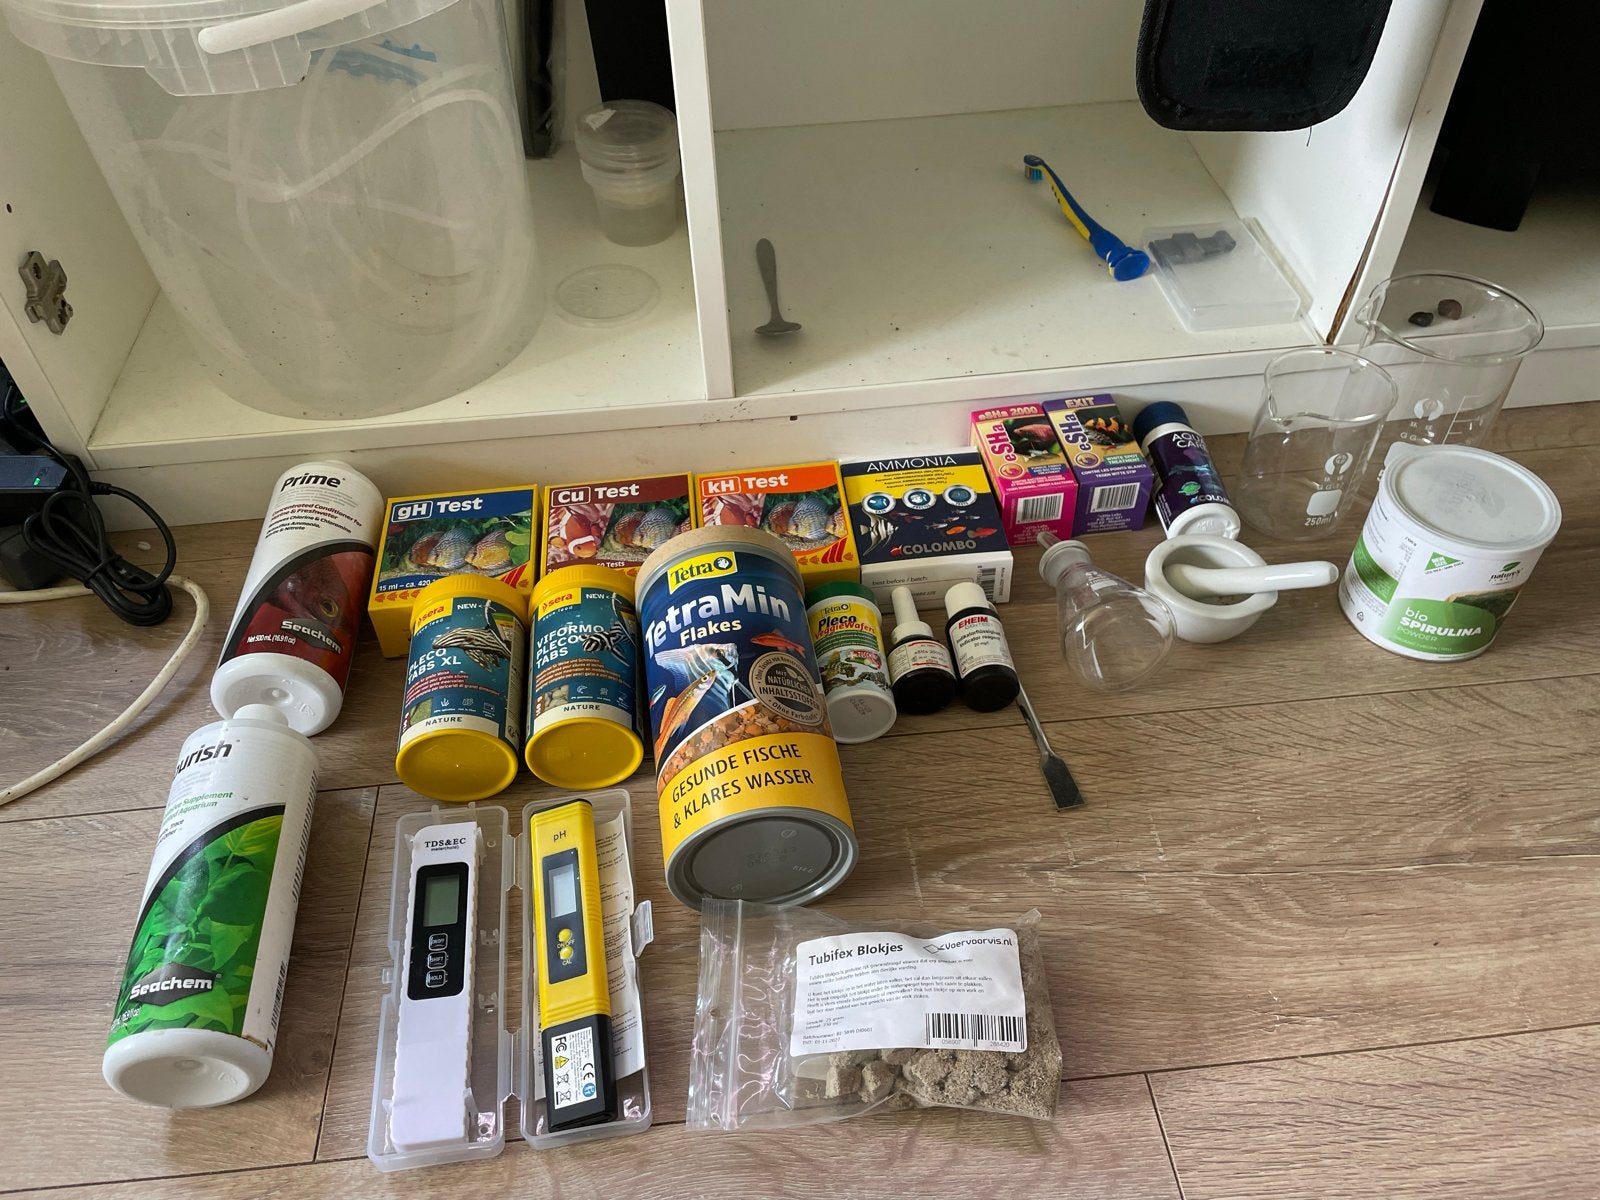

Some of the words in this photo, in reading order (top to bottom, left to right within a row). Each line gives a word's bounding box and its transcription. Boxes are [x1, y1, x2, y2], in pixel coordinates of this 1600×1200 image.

[1065, 397, 1095, 408] EXIT
[978, 409, 1008, 420] eSHa
[1010, 406, 1038, 416] 2000
[1059, 413, 1092, 451] eSHa
[985, 424, 1017, 462] eSHa
[866, 455, 957, 473] AMMONIA
[280, 472, 341, 493] Prime
[707, 480, 735, 494] kH
[743, 473, 789, 489] Test
[558, 489, 585, 504] Cu
[594, 483, 640, 499] Test
[296, 508, 338, 520] Freshwater
[314, 504, 354, 522] Conditioner
[397, 502, 426, 520] gH
[436, 497, 483, 513] Test
[1304, 516, 1332, 526] 250ml
[903, 538, 977, 555] COLOMBO
[670, 562, 714, 586] Tetra
[388, 582, 398, 590] ml
[418, 579, 431, 587] 420
[548, 593, 573, 607] sera
[422, 606, 445, 622] sera
[644, 583, 791, 655] TetraMin
[818, 615, 857, 631] Pleco
[958, 616, 989, 629] EHEIM
[1404, 606, 1428, 622] bio
[680, 618, 742, 647] Flakes
[815, 621, 875, 640] VeggieWafers
[1397, 625, 1438, 642] POWDER
[1399, 616, 1482, 637] SPIRULINA
[281, 620, 341, 654] Seachem
[536, 625, 605, 649] VIFORMO
[536, 635, 579, 660] PLECO
[408, 648, 447, 675] PLECO
[536, 647, 568, 669] TABS
[407, 661, 436, 685] TABS
[440, 656, 461, 667] XL
[767, 675, 814, 698] NATÜRLICHEN
[759, 686, 819, 709] INHALTSSTOFFEN
[563, 704, 601, 712] NATURE
[425, 716, 463, 727] NATURE
[175, 740, 233, 775] urish
[672, 752, 739, 804] GESUNDE
[743, 742, 802, 766] FISCHE
[180, 801, 218, 814] Aquarium
[184, 791, 233, 806] Supplement
[673, 811, 682, 829] &
[684, 780, 741, 820] KLARES
[746, 769, 814, 791] WASSER
[424, 837, 467, 848] TDS&EC
[553, 830, 567, 842] pH
[808, 948, 853, 966] Tubifex
[857, 942, 904, 956] Blokjes
[944, 937, 1013, 951] Voervoorvis.nl
[129, 976, 212, 1000] Seachem
[582, 1062, 594, 1080] CE
